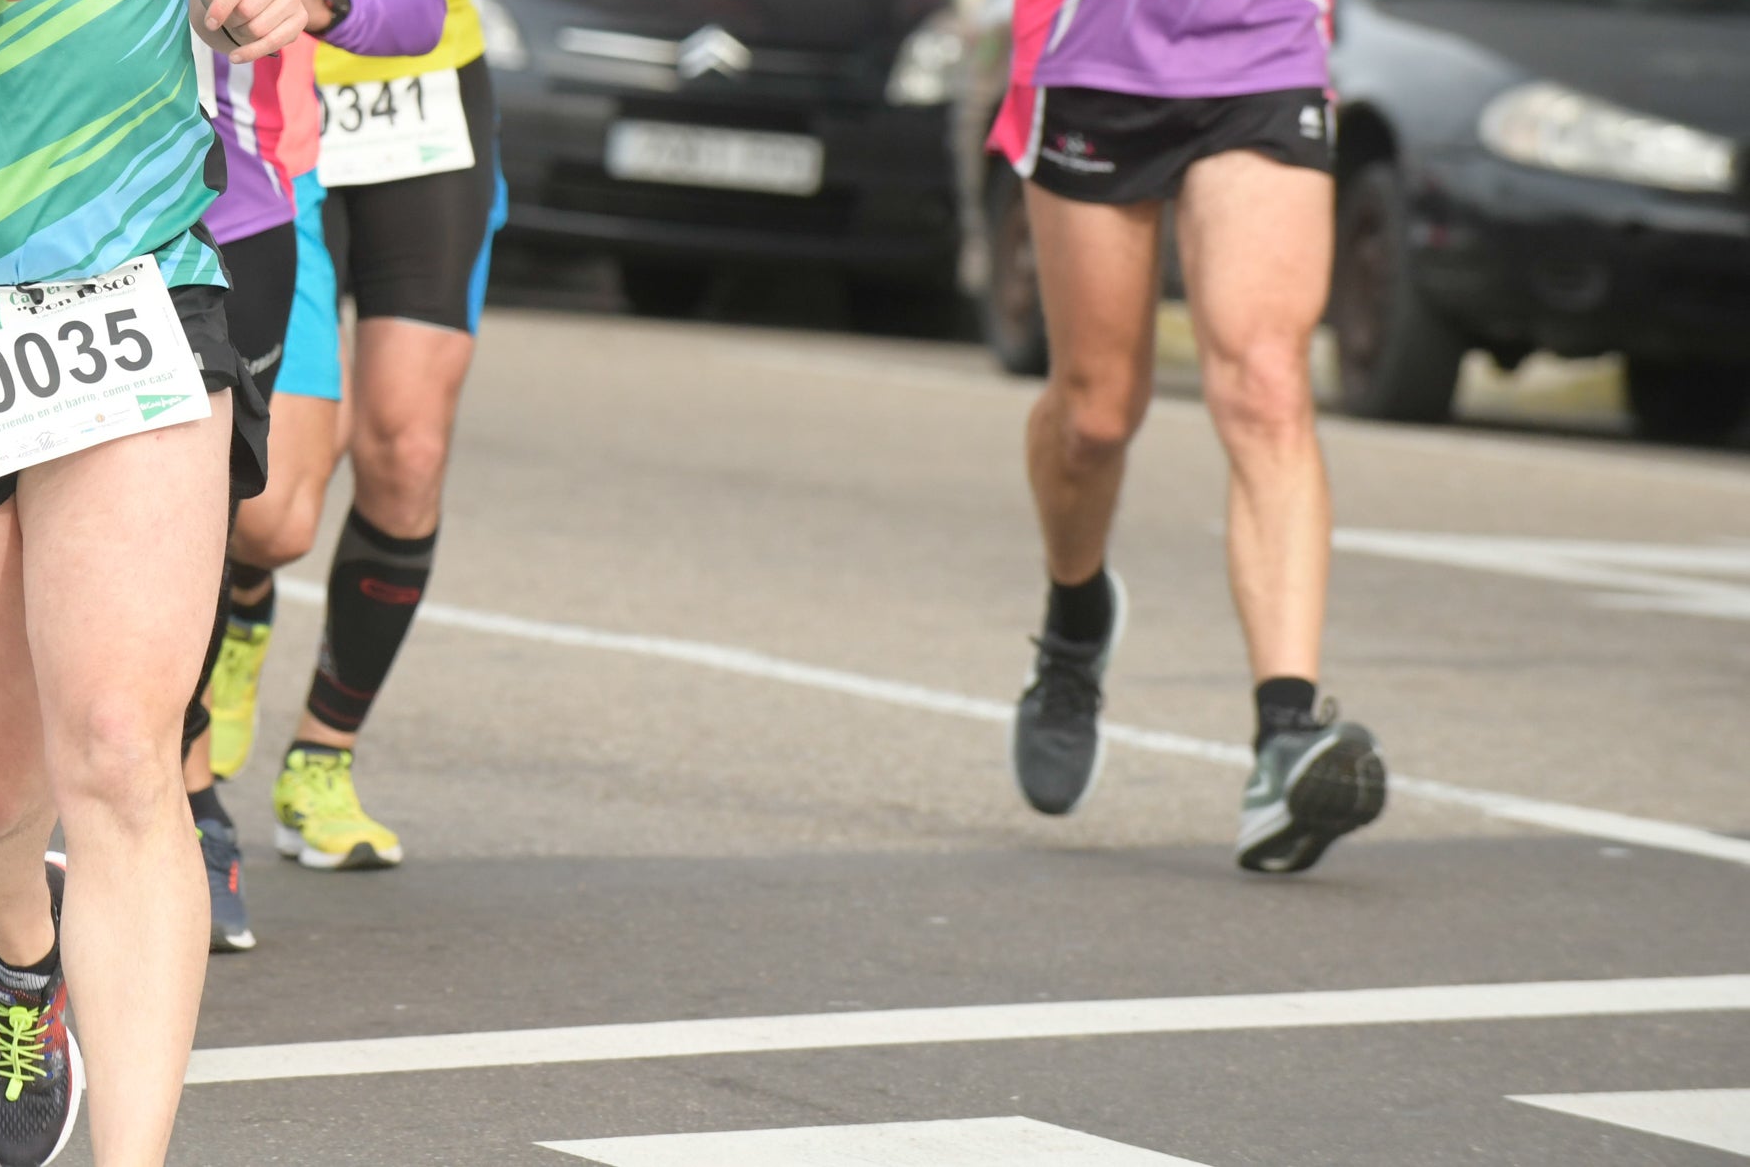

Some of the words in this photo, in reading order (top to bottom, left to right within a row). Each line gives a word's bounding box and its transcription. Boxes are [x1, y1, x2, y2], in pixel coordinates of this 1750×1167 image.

[38, 408, 50, 418] en
[53, 401, 63, 413] el
[103, 384, 130, 398] como
[133, 377, 146, 388] en
